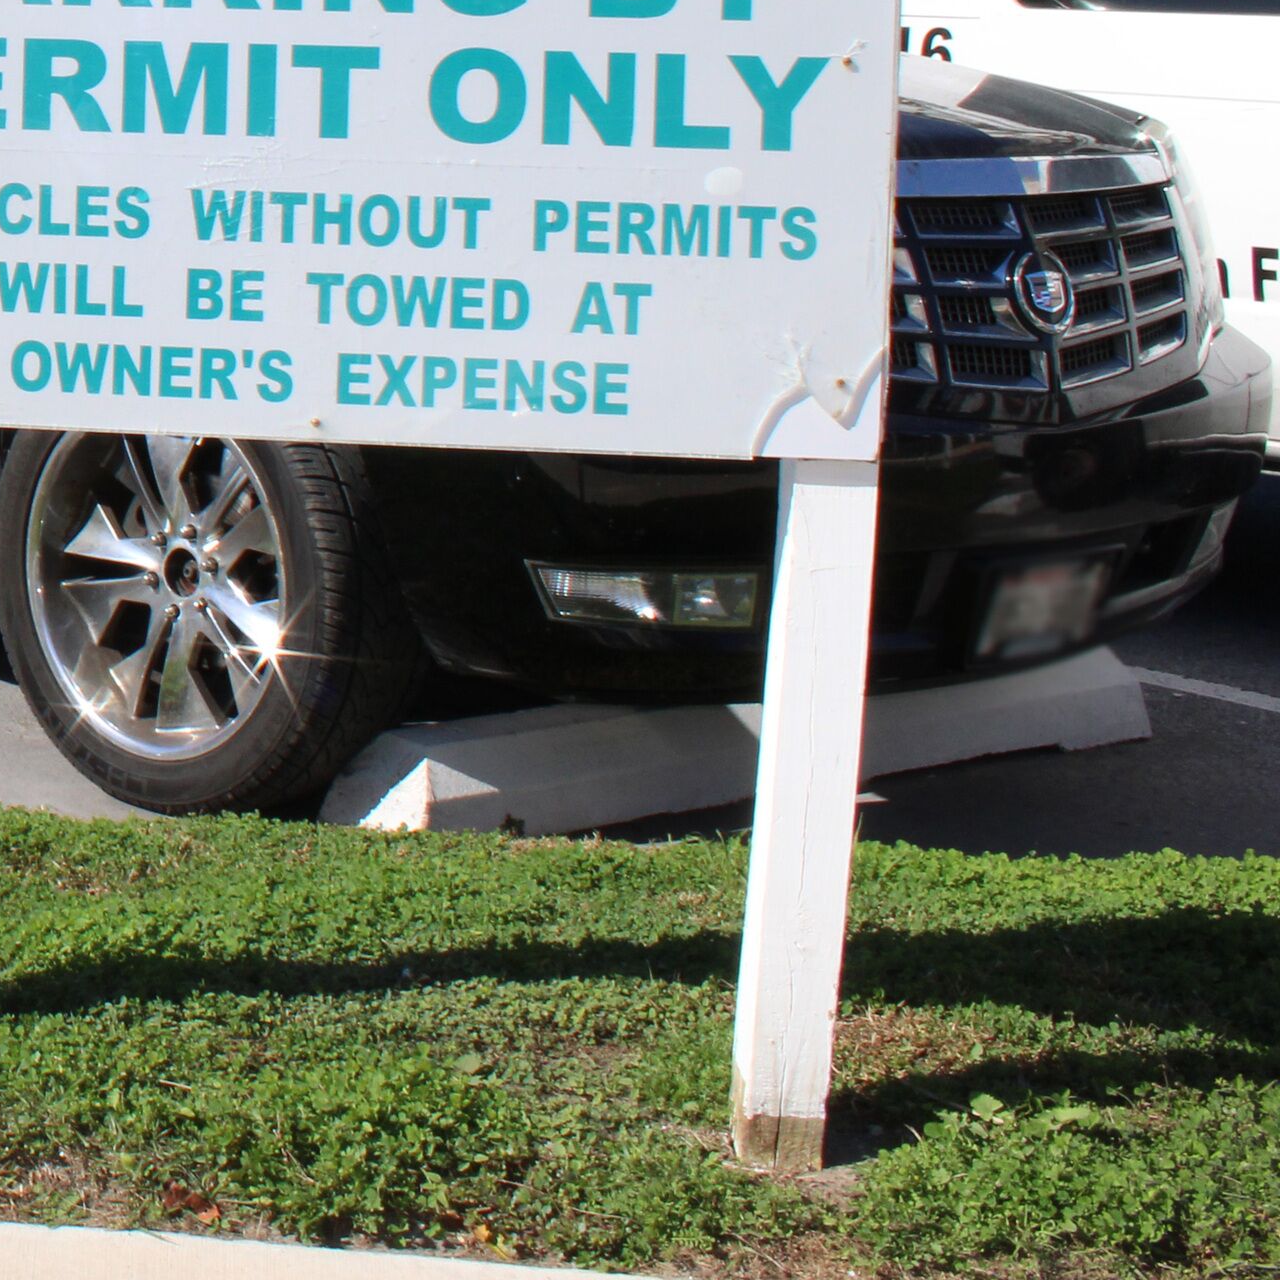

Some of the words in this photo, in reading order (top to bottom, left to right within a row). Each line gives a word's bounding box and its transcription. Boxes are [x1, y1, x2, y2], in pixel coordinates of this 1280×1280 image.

[430, 47, 831, 152] ONLY
[192, 189, 493, 250] WITHOUT
[535, 199, 819, 261] PERMITS
[187, 268, 266, 323] BE
[307, 272, 531, 331] TOWED
[573, 282, 654, 336] AT
[12, 340, 295, 404] OWNER'S
[338, 353, 630, 416] EXPENSE
